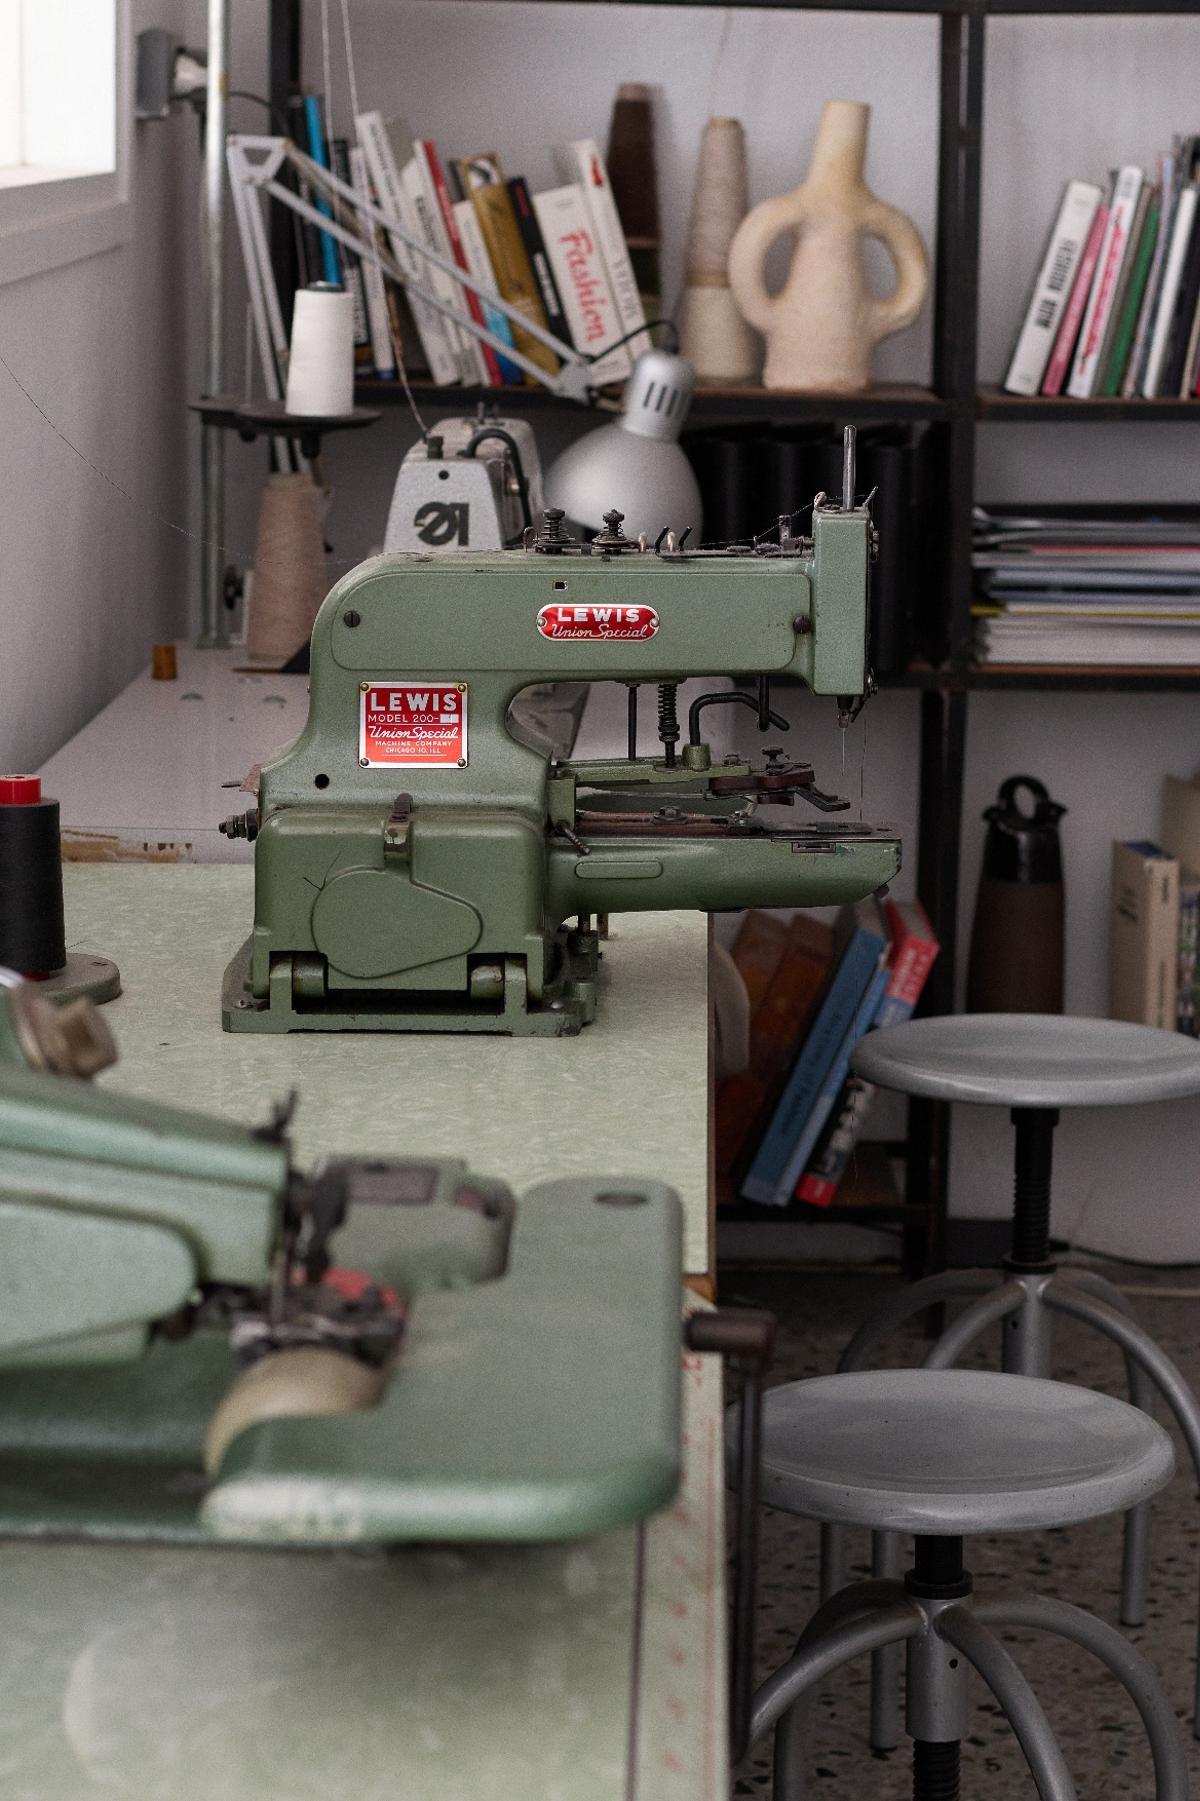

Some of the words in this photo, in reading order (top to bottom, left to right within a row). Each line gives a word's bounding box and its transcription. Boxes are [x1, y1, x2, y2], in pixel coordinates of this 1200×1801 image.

[559, 229, 606, 342] Fashion
[557, 607, 640, 622] LEWIS
[551, 624, 593, 637] Union
[594, 624, 648, 639] Special
[370, 692, 457, 712] LEWIS
[368, 714, 408, 723] MODEL
[368, 725, 410, 738] Union
[411, 726, 459, 740] Special
